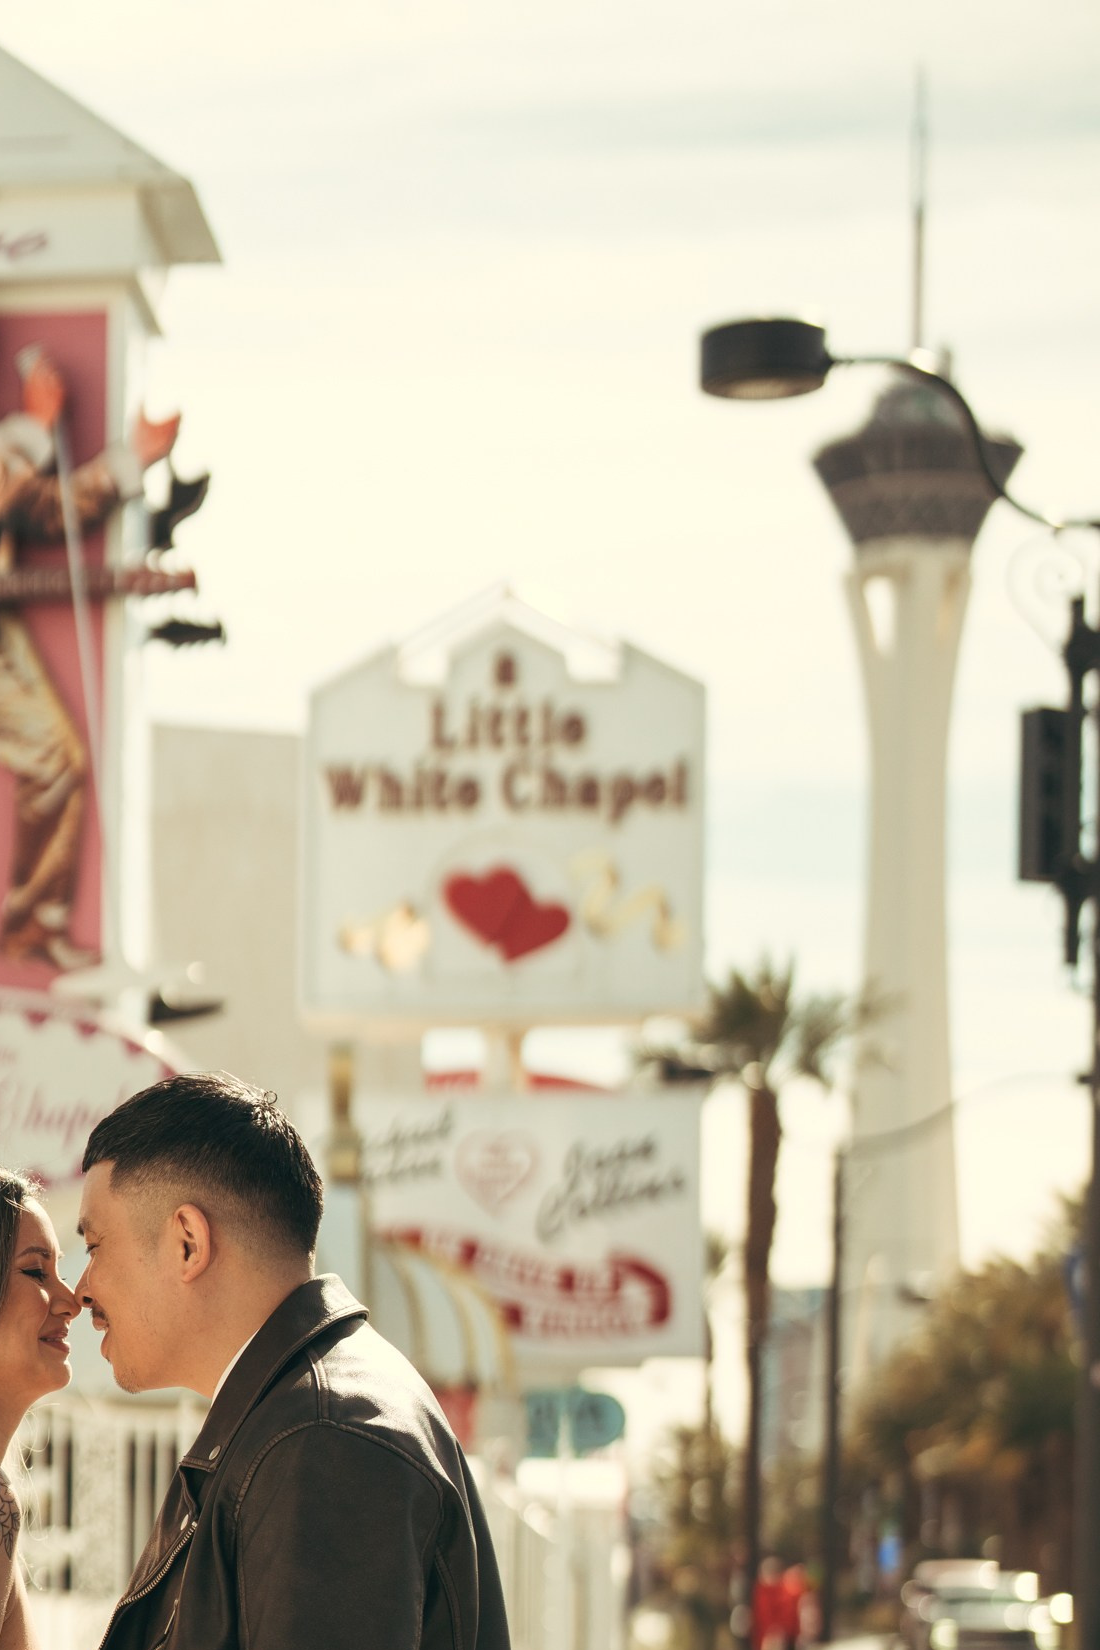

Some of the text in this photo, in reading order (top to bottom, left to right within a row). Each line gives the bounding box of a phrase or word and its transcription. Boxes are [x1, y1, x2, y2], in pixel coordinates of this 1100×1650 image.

[431, 697, 587, 751] Little
[325, 757, 690, 828] White Chapel
